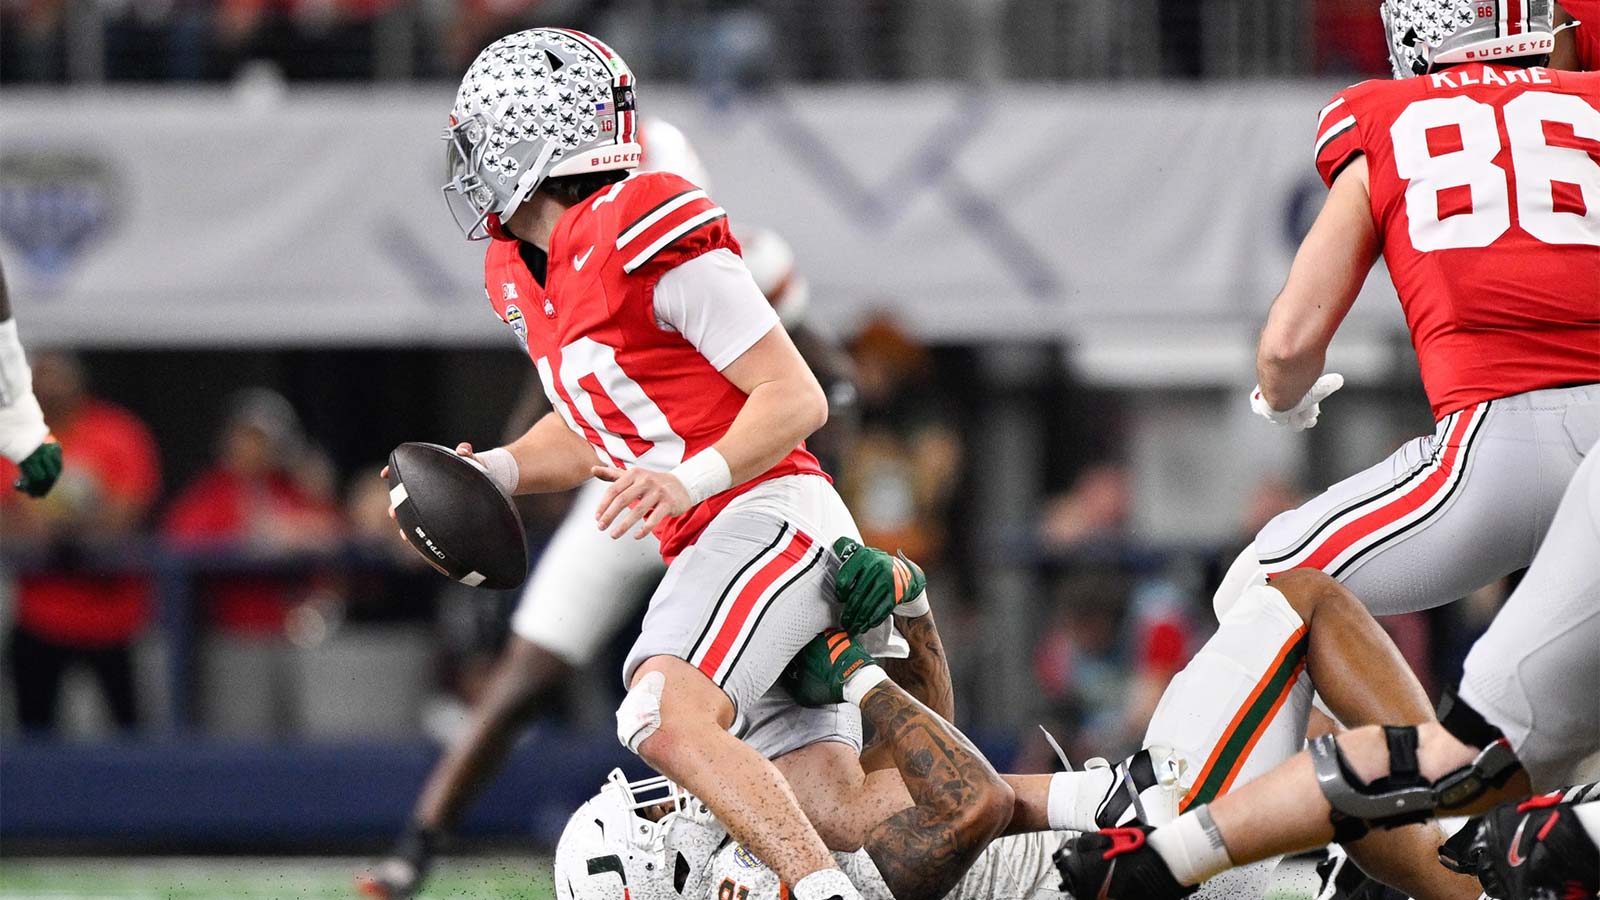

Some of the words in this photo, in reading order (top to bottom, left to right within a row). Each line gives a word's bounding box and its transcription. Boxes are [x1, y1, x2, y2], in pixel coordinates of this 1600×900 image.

[1477, 6, 1493, 18] 86
[1465, 39, 1552, 59] BUCKEYES
[601, 119, 613, 132] 10
[1389, 90, 1600, 252] 86
[537, 335, 686, 471] 10
